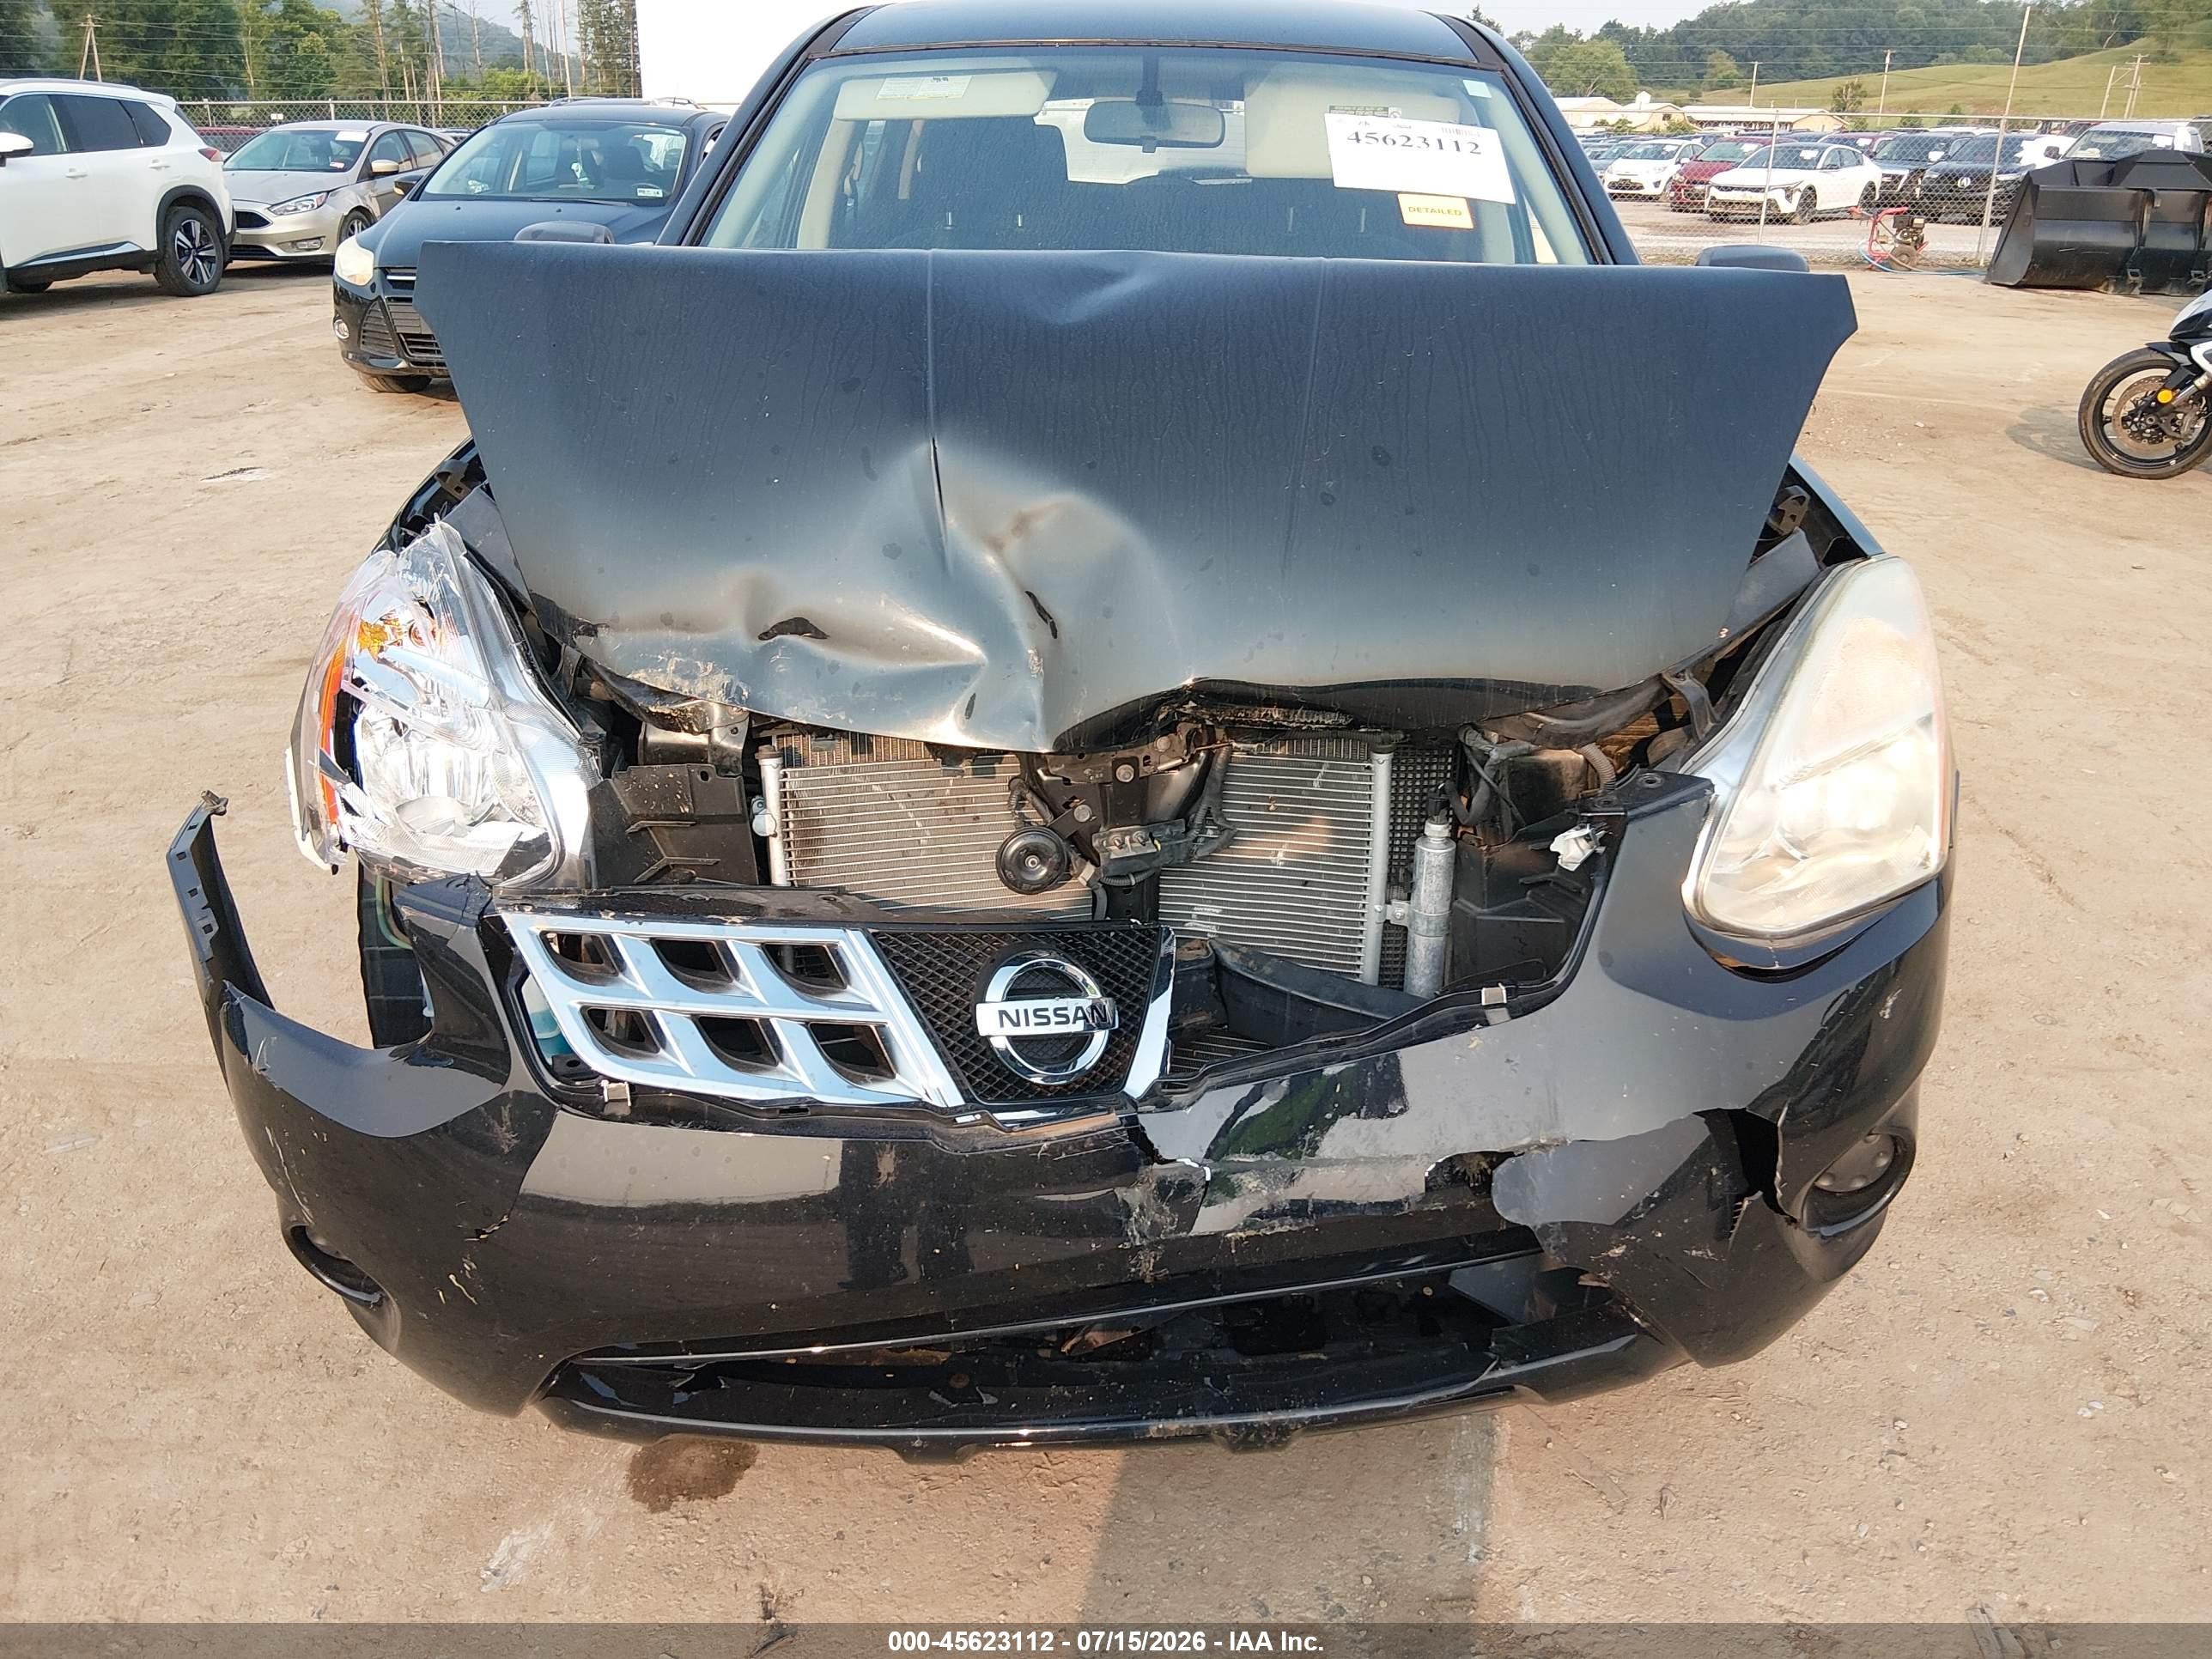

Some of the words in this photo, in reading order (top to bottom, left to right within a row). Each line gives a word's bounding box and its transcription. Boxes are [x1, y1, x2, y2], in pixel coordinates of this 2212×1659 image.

[1346, 131, 1482, 155] 45623112
[1407, 205, 1462, 216] DETAILED
[997, 1006, 1111, 1028] NISSAN
